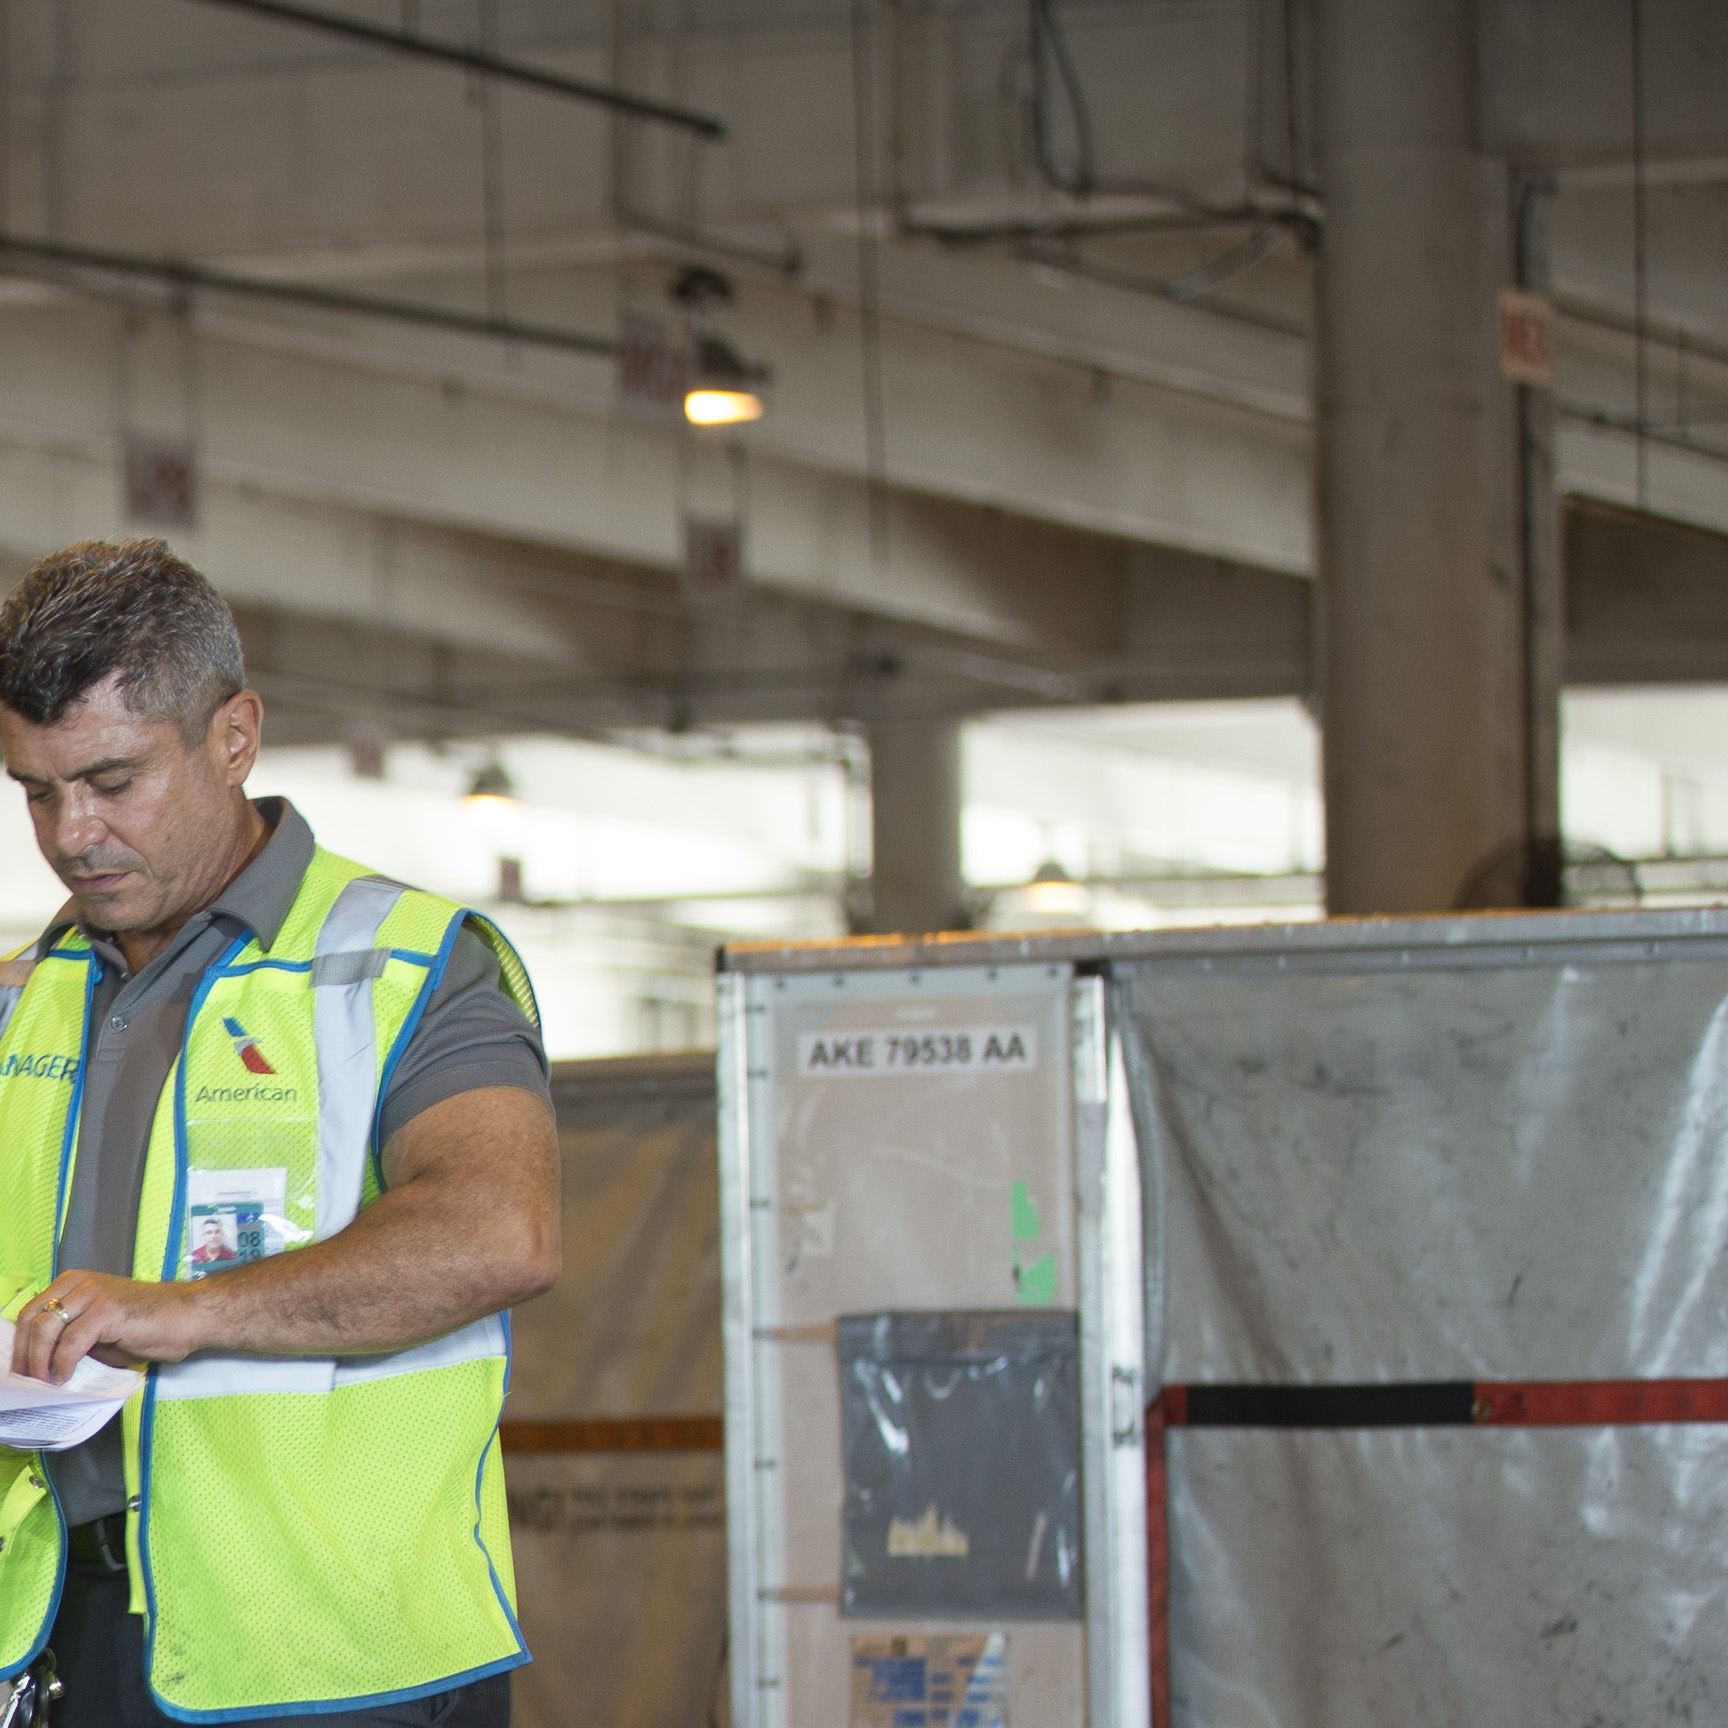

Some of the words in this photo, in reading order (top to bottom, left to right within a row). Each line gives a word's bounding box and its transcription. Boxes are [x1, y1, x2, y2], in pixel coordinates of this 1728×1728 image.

[809, 1038, 878, 1069] AKE
[886, 1035, 973, 1066] 79538
[982, 1033, 1027, 1063] AA
[195, 1082, 299, 1103] American
